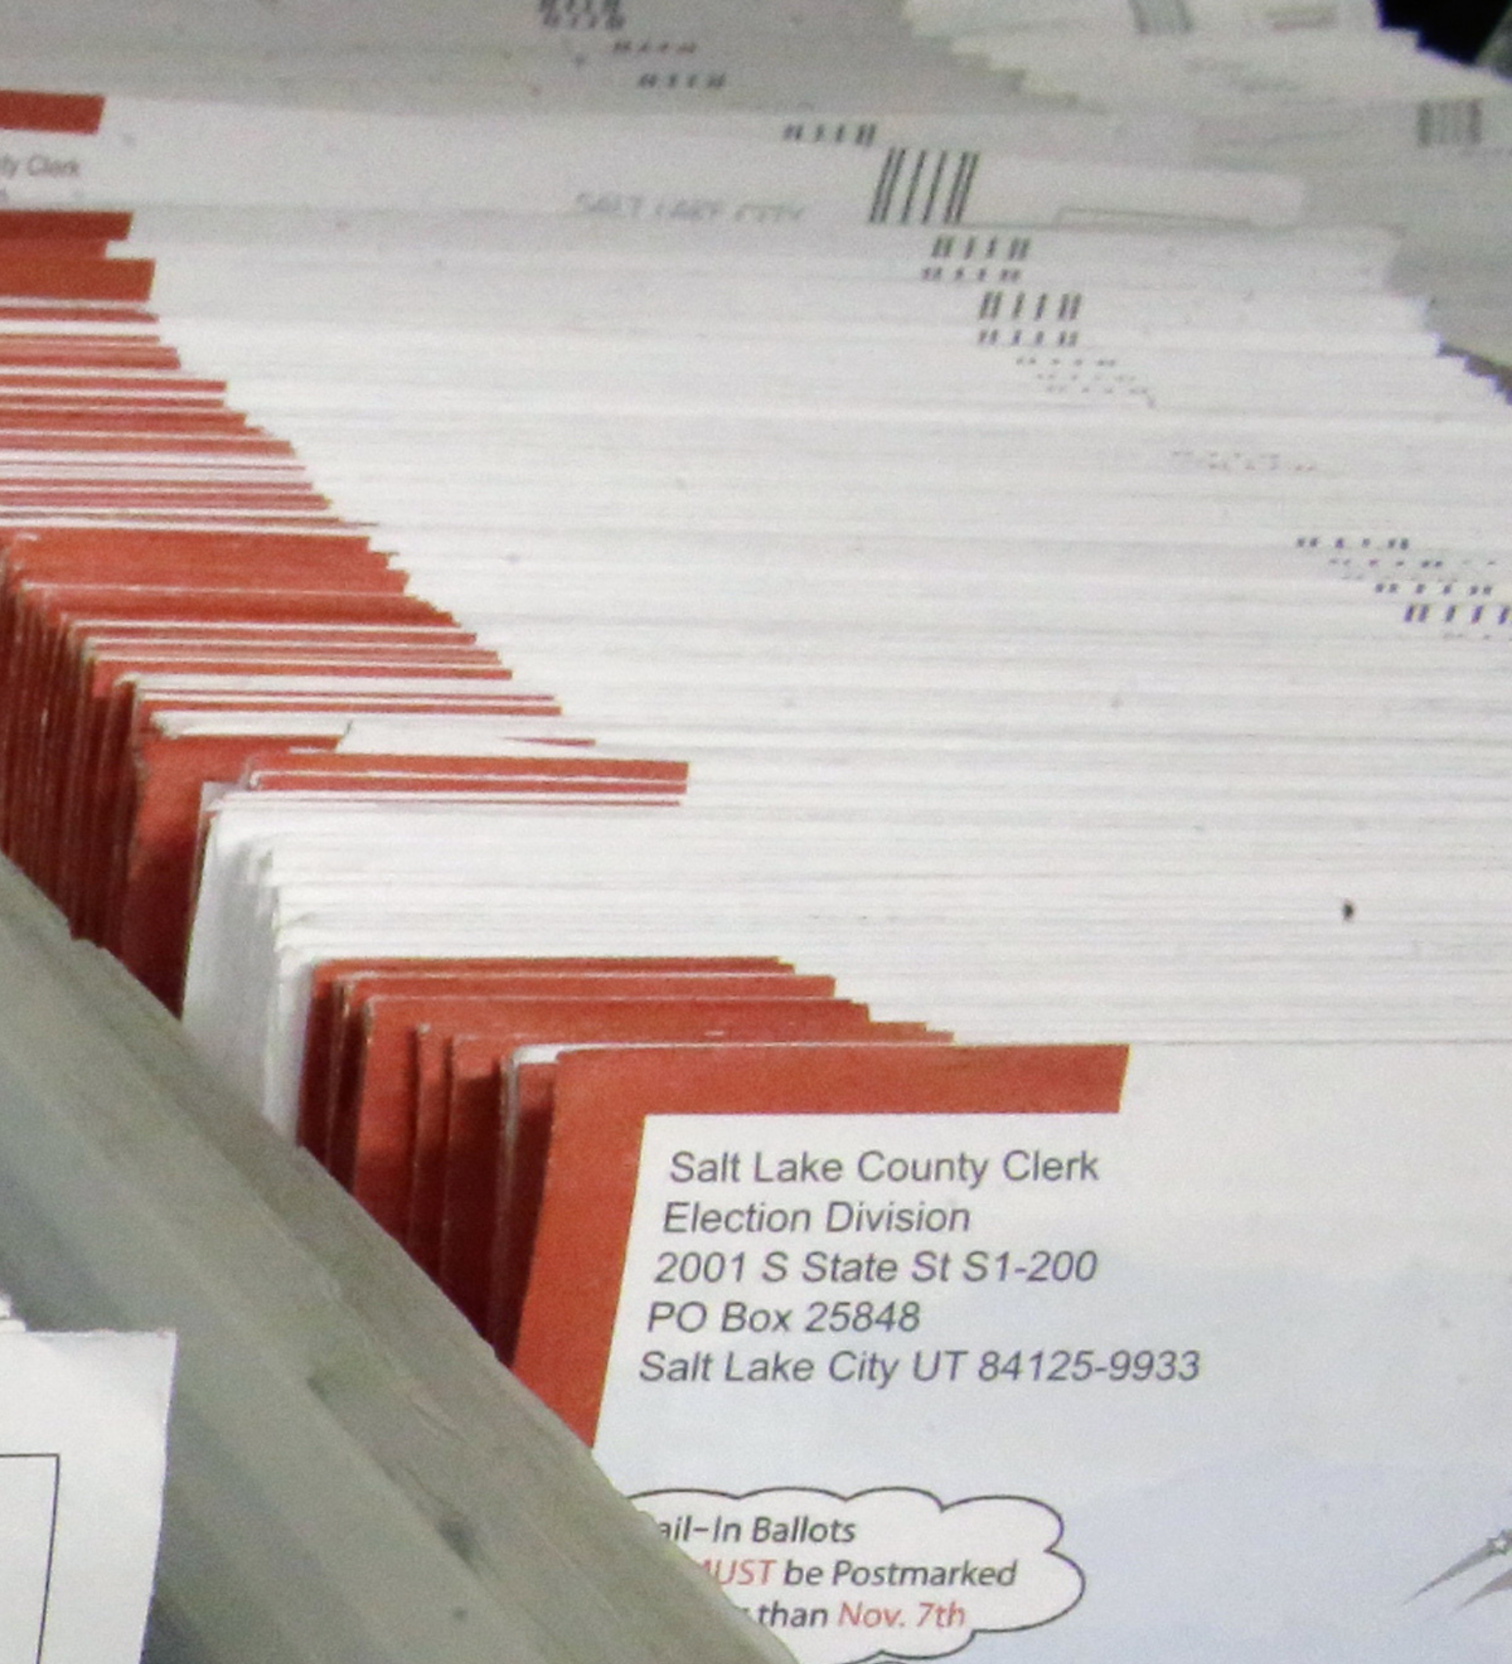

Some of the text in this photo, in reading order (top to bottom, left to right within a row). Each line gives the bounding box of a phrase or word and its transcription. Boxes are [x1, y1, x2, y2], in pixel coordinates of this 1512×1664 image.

[669, 1148, 1099, 1191] Salt Lake County Clerk
[663, 1200, 971, 1234] Election Division
[653, 1249, 1099, 1284] 2001 S State St S1-200
[647, 1300, 921, 1334] PO Box 25848
[638, 1349, 1201, 1390] Salt Lake City UT 84125-9933
[656, 1515, 856, 1544] ail-In Ballots
[783, 1558, 825, 1587] be
[831, 1559, 1018, 1587] Postmarked
[758, 1601, 828, 1627] than
[838, 1602, 905, 1628] Nov.
[915, 1602, 966, 1628] 7th
